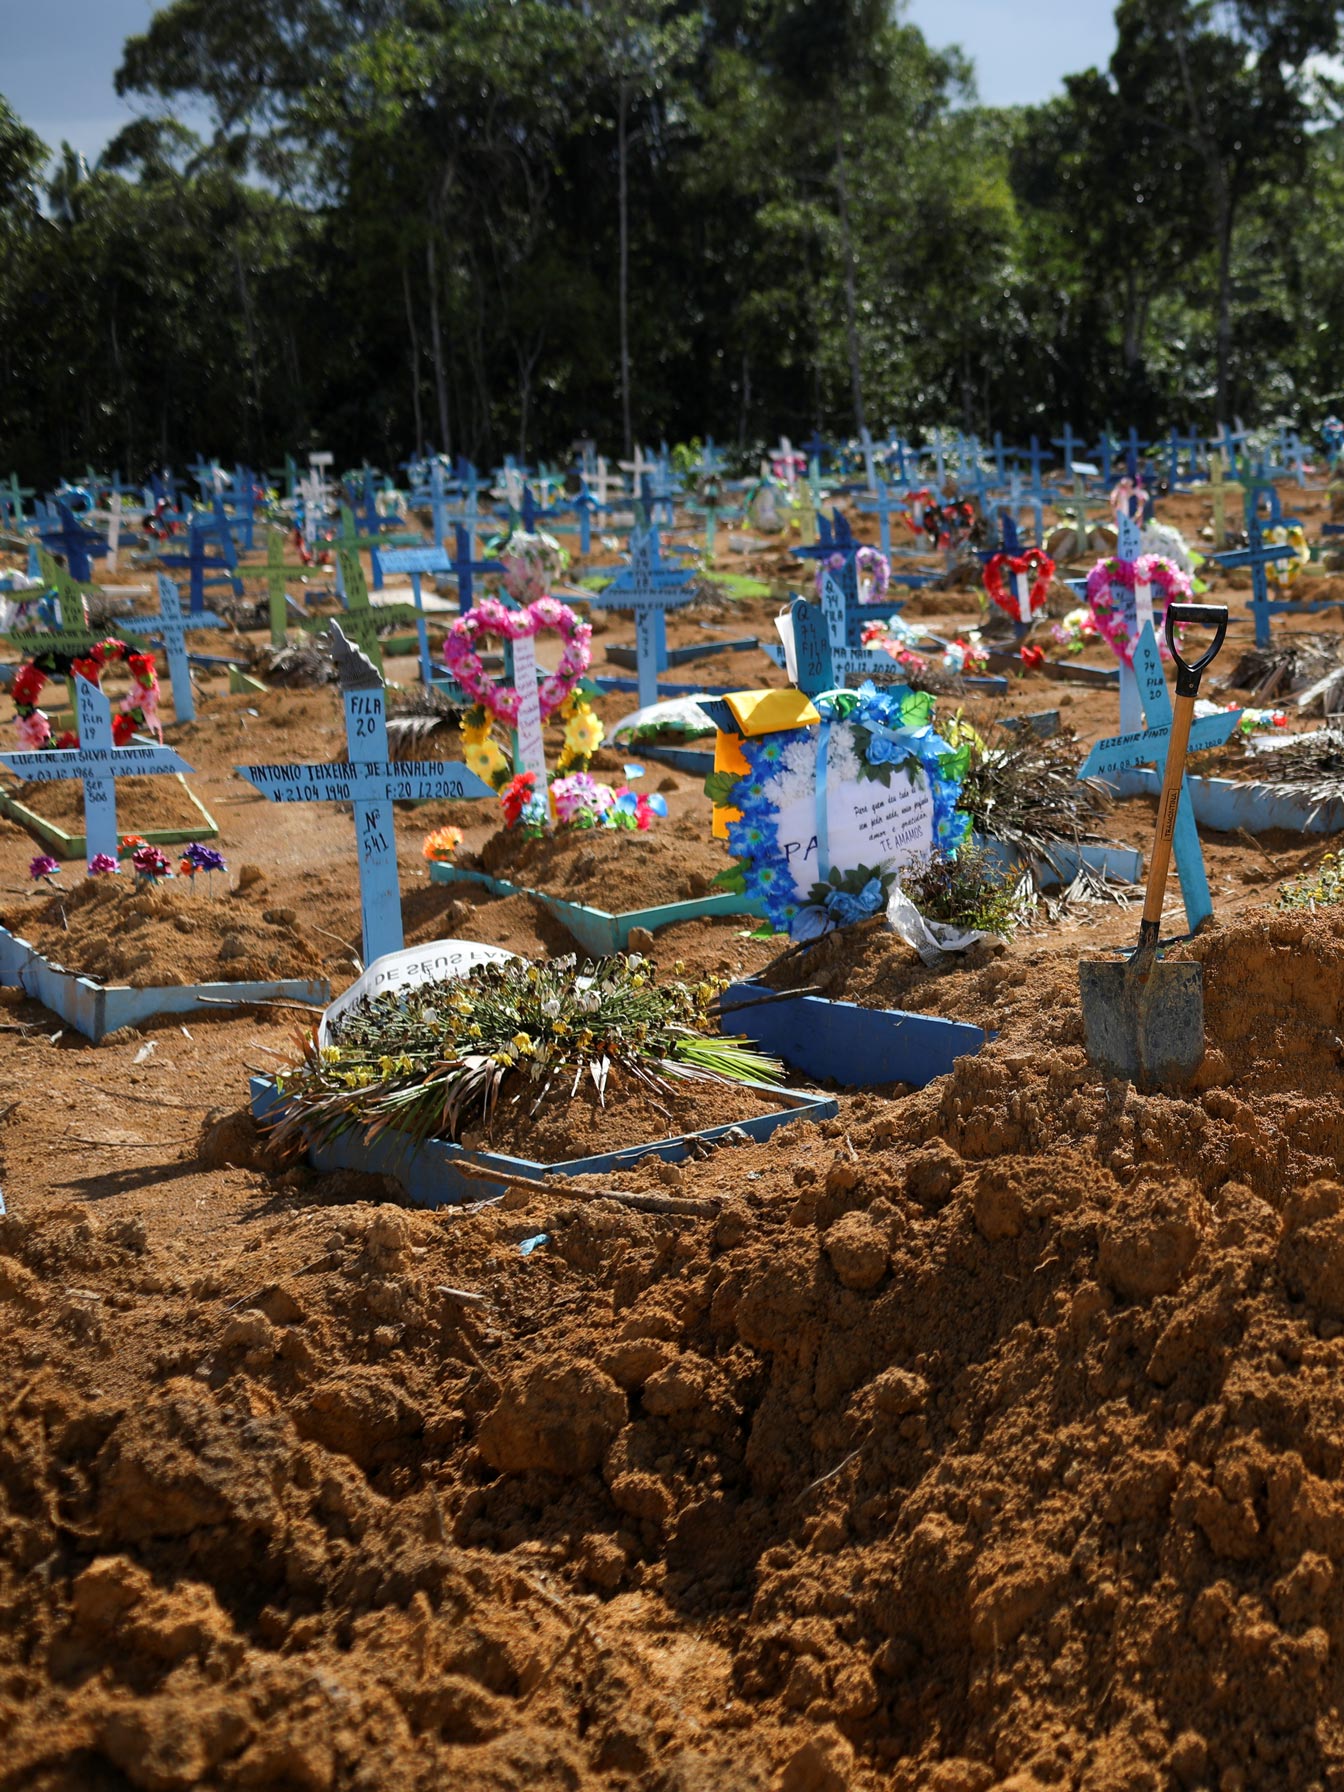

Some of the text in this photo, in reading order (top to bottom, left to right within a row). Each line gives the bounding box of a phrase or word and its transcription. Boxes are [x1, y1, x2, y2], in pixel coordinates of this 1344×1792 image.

[826, 580, 833, 593] Q
[826, 594, 839, 608] 74
[797, 604, 808, 622] Q
[801, 623, 816, 639] 74
[831, 624, 837, 638] 9
[808, 660, 822, 676] 20
[1144, 662, 1155, 672] 74
[81, 683, 91, 697] Q
[1150, 690, 1162, 700] 20
[81, 698, 94, 712] 74
[351, 697, 381, 715] FILA
[85, 727, 96, 740] 19
[357, 717, 376, 737] 20
[1100, 730, 1141, 750] ELZENIR
[79, 749, 107, 762] SILVA
[110, 748, 155, 761] OLIVEIRA
[249, 765, 301, 782] ANTONIO
[306, 763, 358, 782] TEIXEIRA
[1164, 792, 1177, 838] TRAMONTINA
[364, 833, 389, 856] 541
[880, 825, 923, 852] TE AMAMOS
